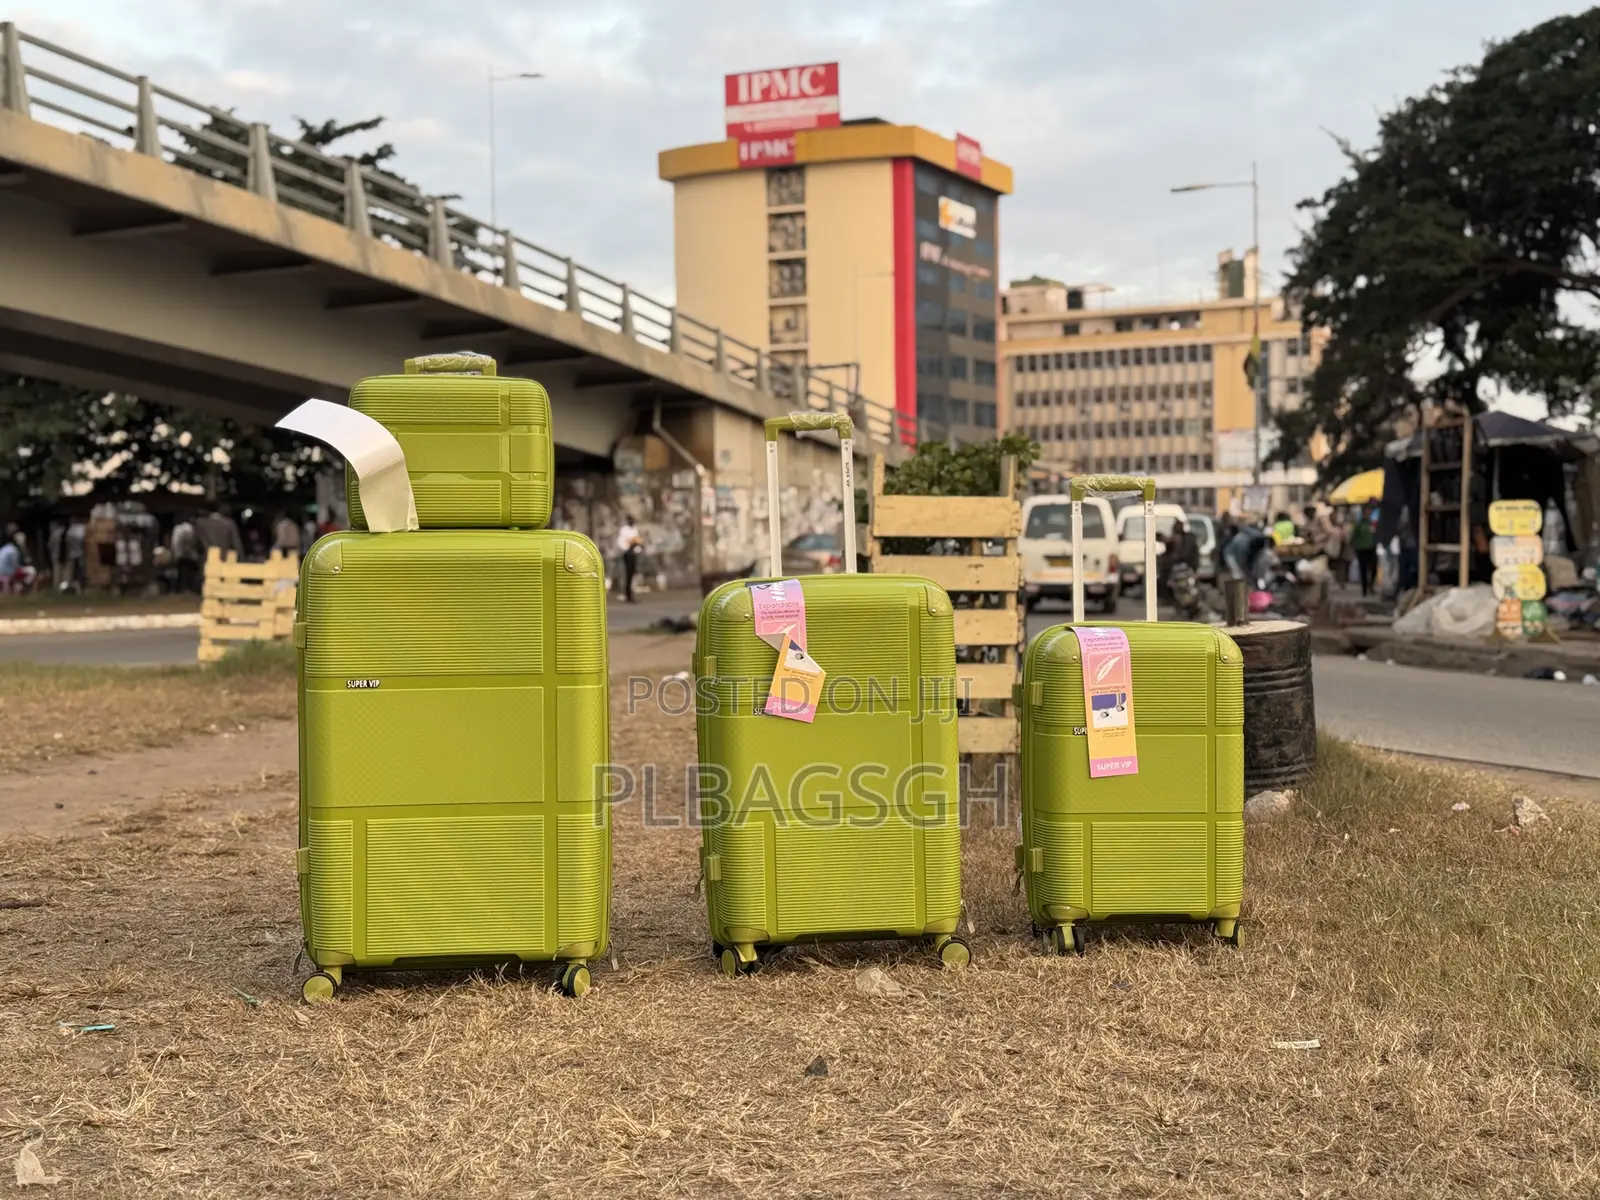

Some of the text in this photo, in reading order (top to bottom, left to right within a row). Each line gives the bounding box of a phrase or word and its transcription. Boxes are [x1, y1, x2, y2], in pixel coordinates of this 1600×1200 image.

[738, 65, 826, 103] IPMC
[740, 137, 796, 162] IPMC
[759, 601, 800, 610] Expandable
[347, 679, 380, 688] SUPER VIP
[1096, 760, 1132, 771] SUPER VIP
